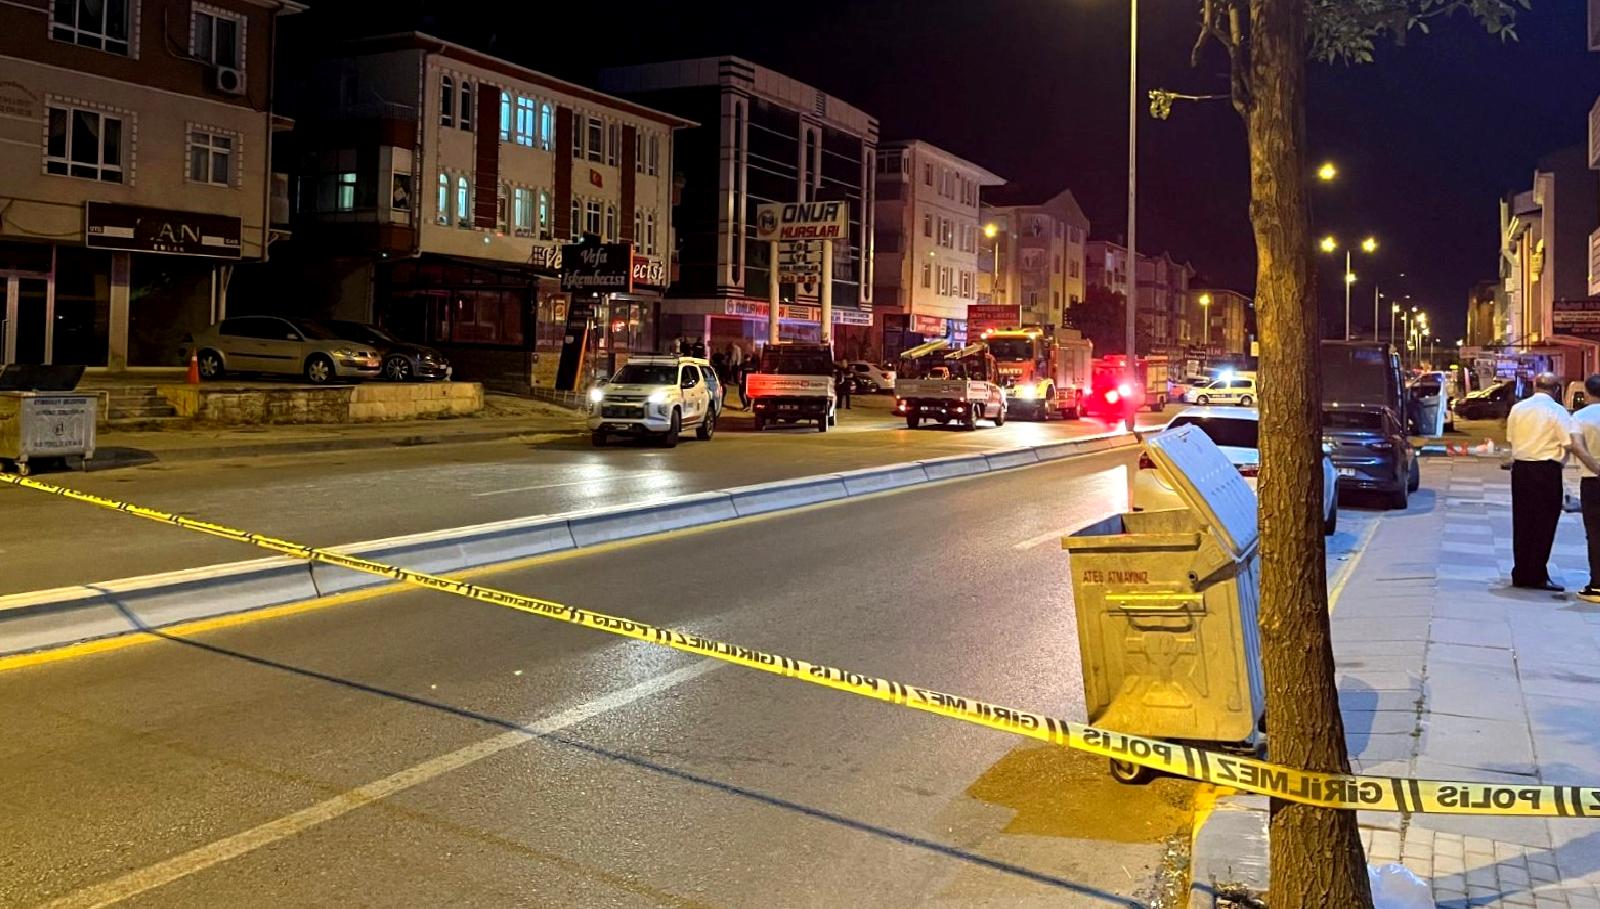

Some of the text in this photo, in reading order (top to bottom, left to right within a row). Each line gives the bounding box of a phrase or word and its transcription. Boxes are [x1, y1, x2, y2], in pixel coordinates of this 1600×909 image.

[782, 203, 839, 222] ONUR
[781, 225, 839, 238] KURSLARI
[542, 245, 562, 269] Ve
[581, 247, 608, 268] Vefa
